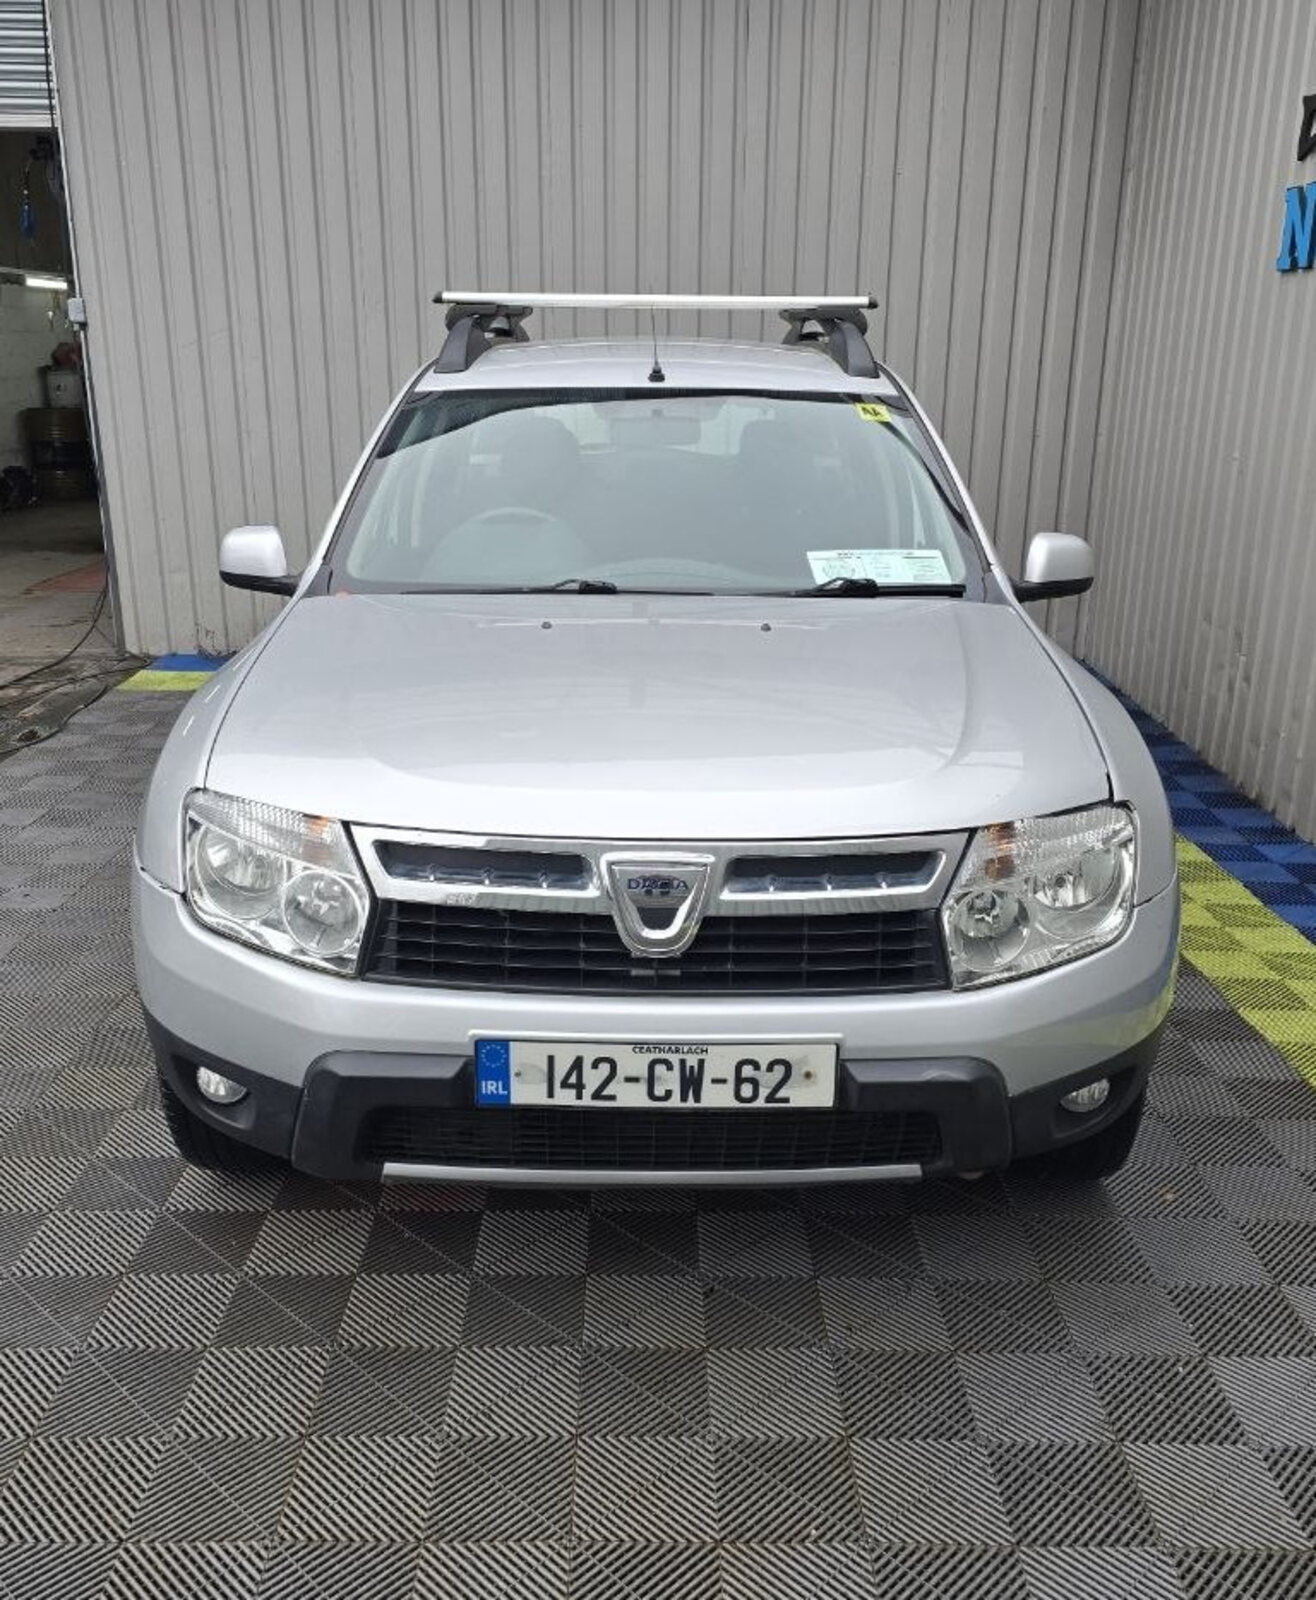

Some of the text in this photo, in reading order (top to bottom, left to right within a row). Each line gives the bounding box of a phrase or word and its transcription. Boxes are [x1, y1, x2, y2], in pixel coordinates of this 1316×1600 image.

[632, 1046, 709, 1055] CEATHARLACH
[546, 1055, 793, 1104] 142-CW-62
[481, 1080, 508, 1096] IRL
